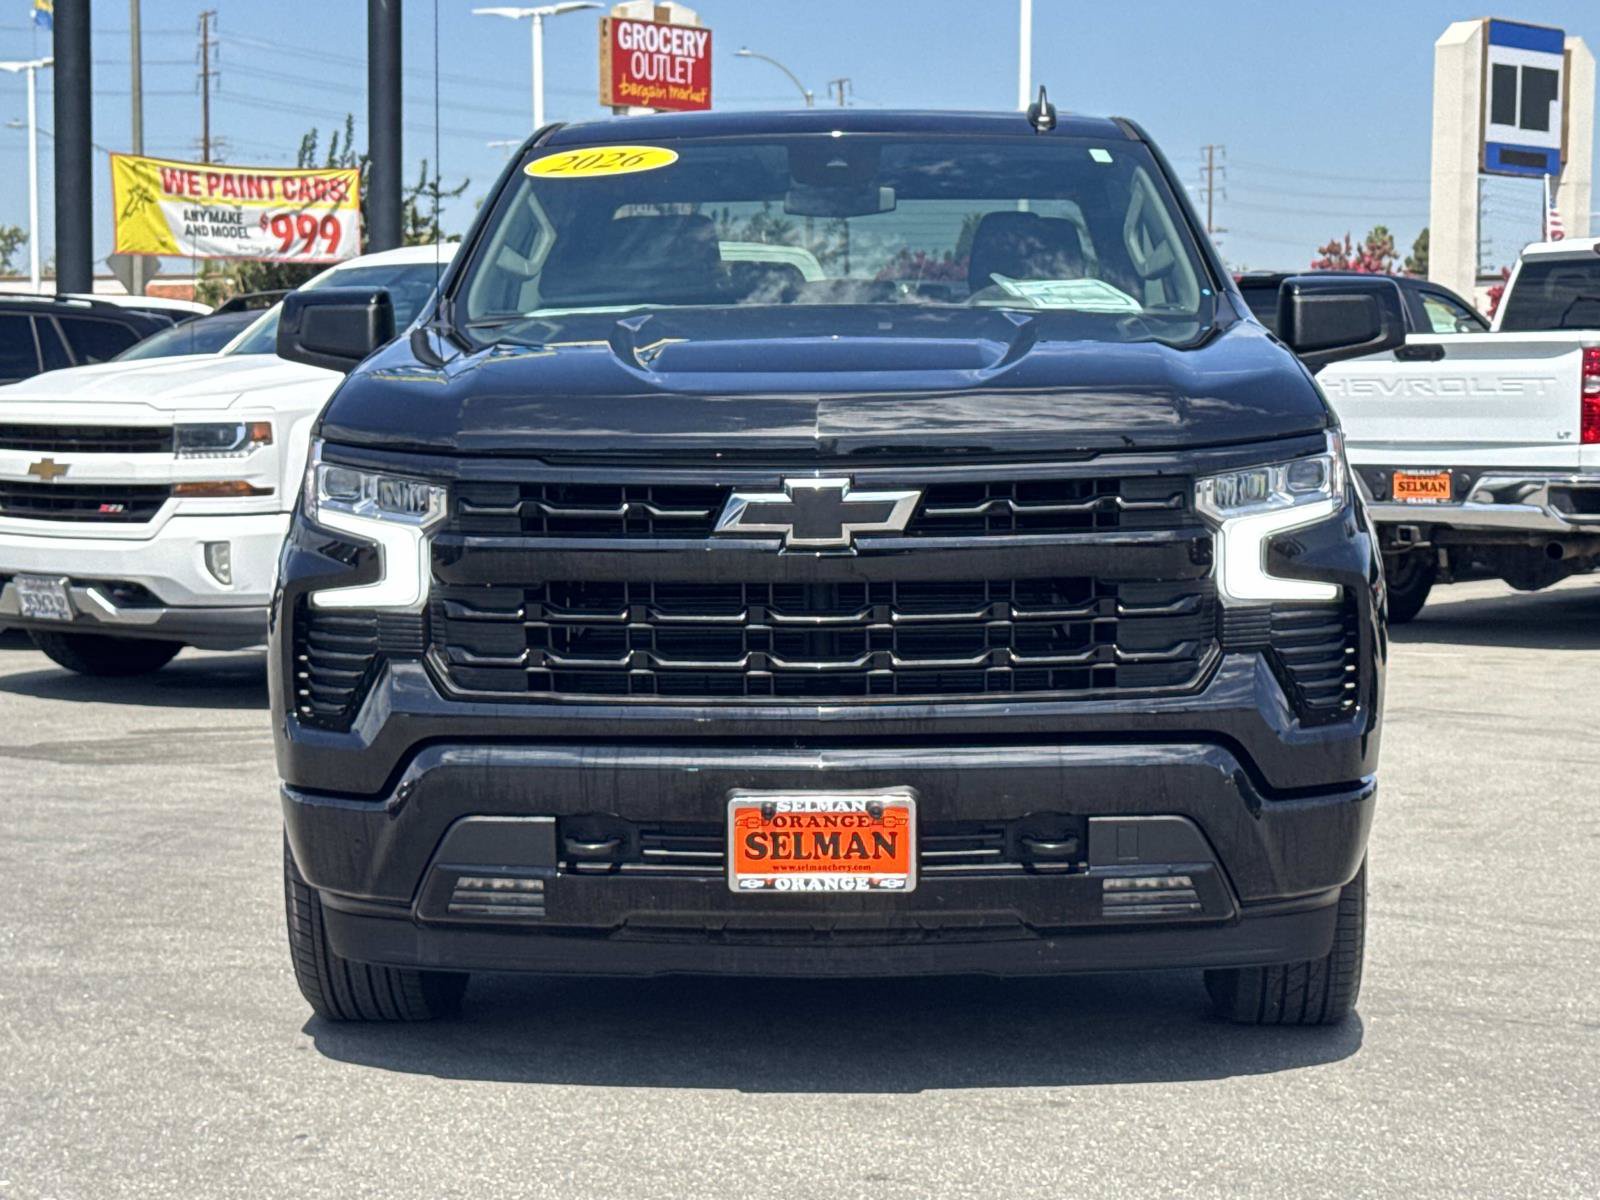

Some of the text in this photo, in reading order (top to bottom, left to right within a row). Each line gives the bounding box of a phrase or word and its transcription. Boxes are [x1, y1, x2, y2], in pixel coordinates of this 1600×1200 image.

[618, 22, 708, 59] GROCERY
[631, 51, 696, 84] OUTLET
[618, 73, 708, 105] bargain market
[546, 151, 656, 173] 2026
[160, 167, 202, 196] WE
[205, 171, 277, 200] PAINT
[183, 209, 243, 226] ANY MAKE
[185, 224, 250, 240] AND MODEL
[259, 211, 342, 254] $999
[1321, 376, 1557, 396] HEVROLET
[1398, 481, 1447, 493] SELMAN
[776, 800, 867, 812] SELMAN
[772, 815, 870, 828] ORANGE
[744, 831, 899, 860] SELMAN
[772, 864, 871, 873] www.selmanchevy.com
[774, 878, 870, 891] ORANGE
